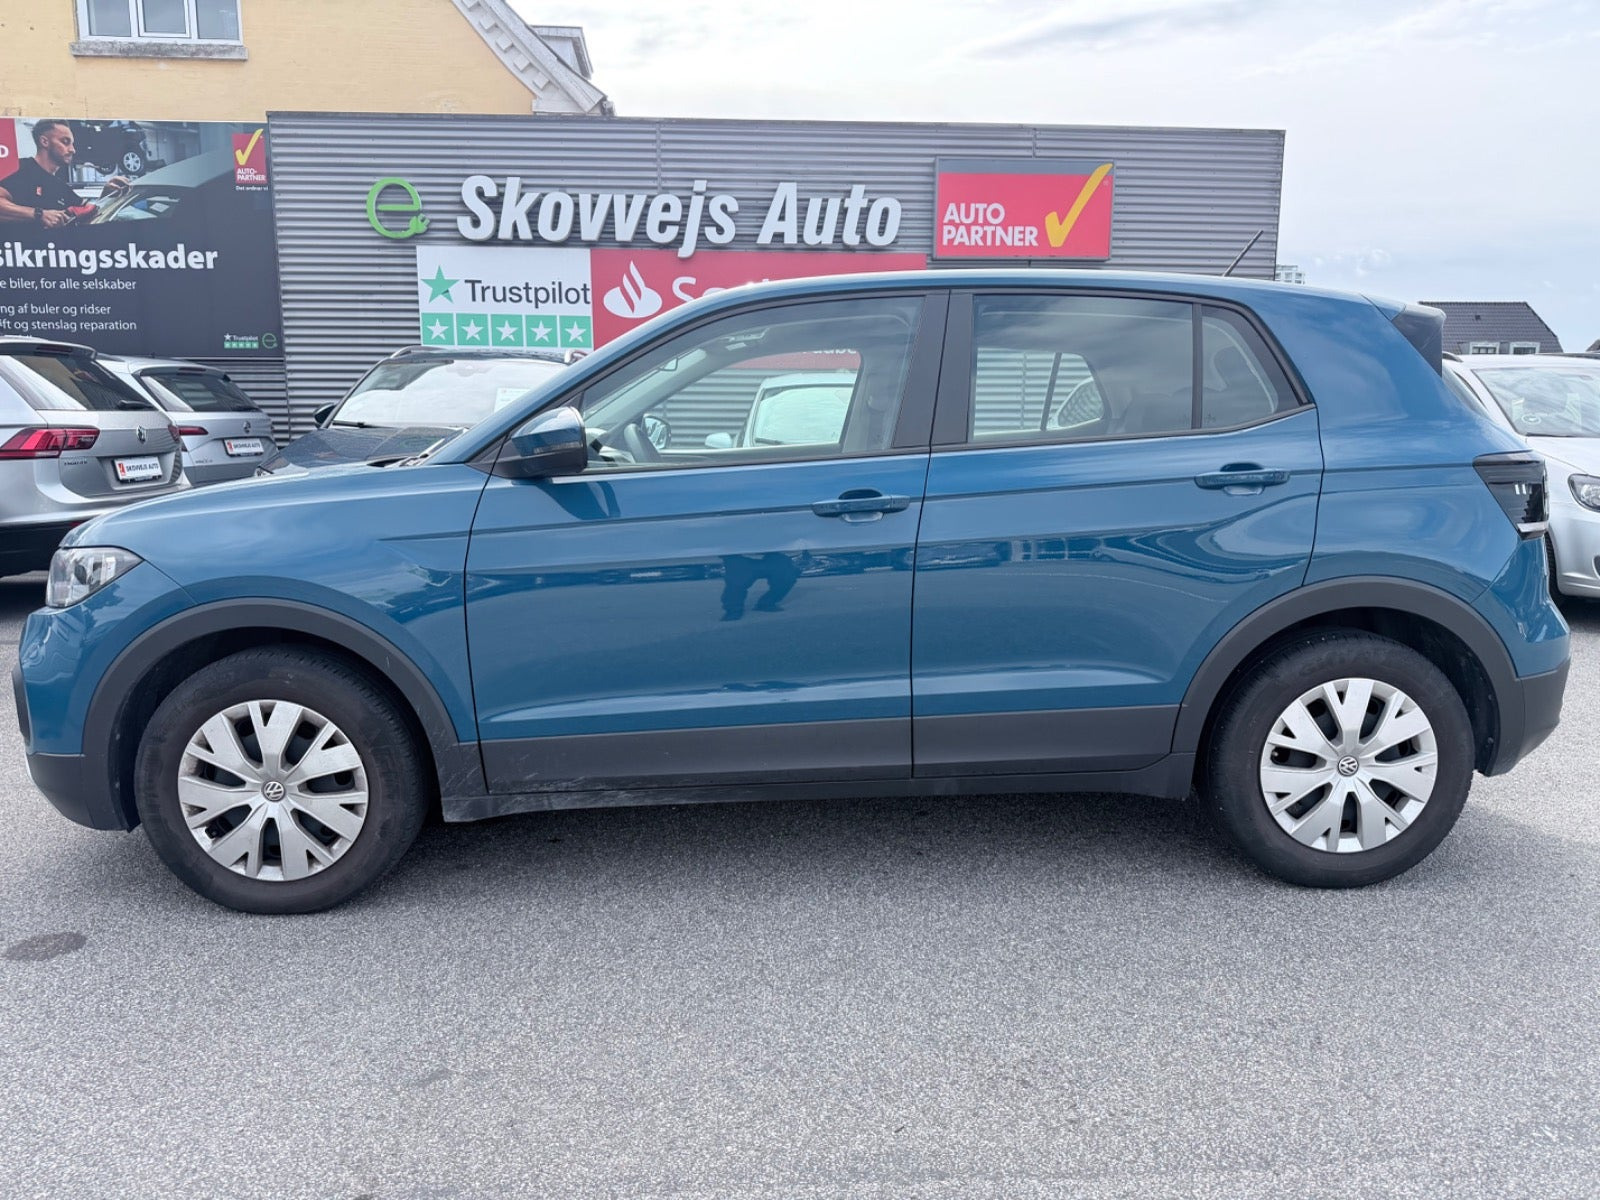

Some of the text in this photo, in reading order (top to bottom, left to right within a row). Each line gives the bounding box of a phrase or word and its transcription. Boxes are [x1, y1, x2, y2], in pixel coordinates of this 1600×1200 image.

[456, 175, 902, 258] Skovvejs Auto
[942, 203, 1005, 224] AUTO
[942, 225, 1038, 247] PARTNER
[9, 277, 38, 290] biler,
[40, 277, 57, 289] for
[59, 278, 80, 289] alle
[82, 278, 137, 290] selskaber
[464, 279, 591, 309] Trustpilot
[17, 303, 28, 314] af
[30, 303, 60, 314] buler
[62, 305, 77, 317] og
[80, 304, 111, 315] ridser
[13, 320, 29, 332] og
[31, 319, 77, 332] stenslag
[80, 319, 137, 332] reparation
